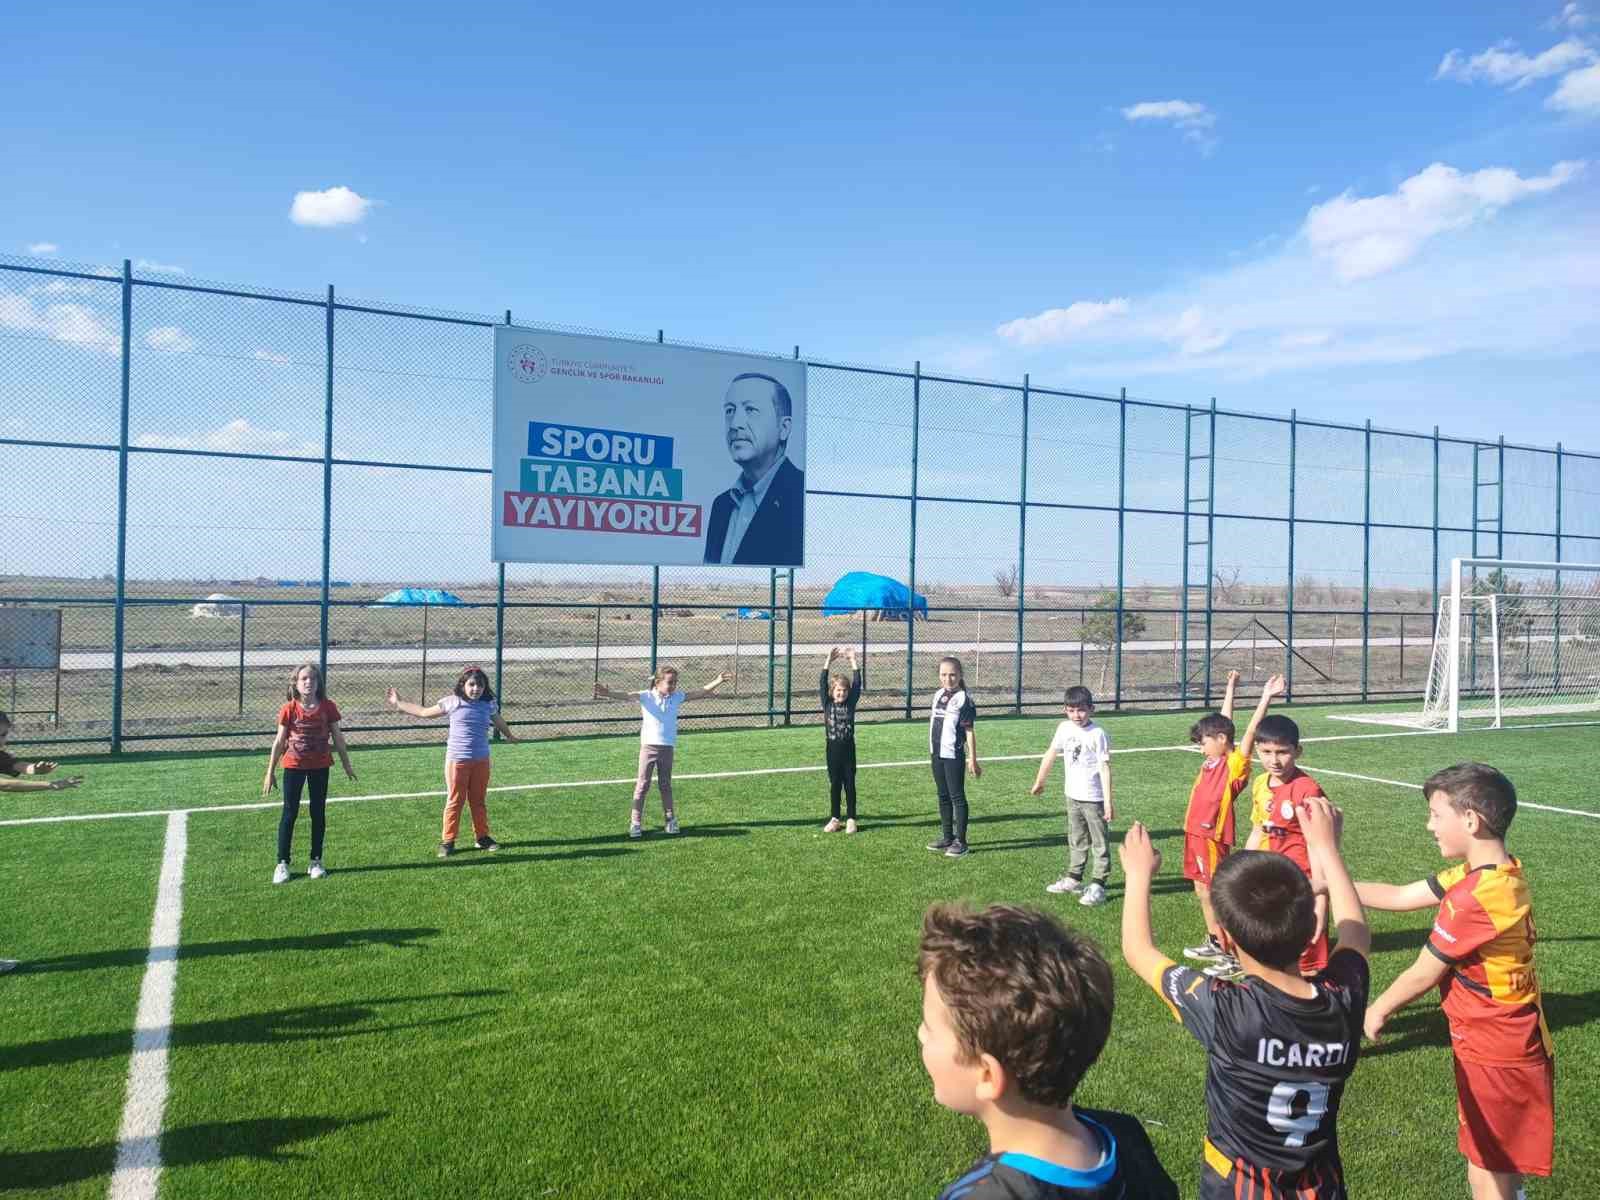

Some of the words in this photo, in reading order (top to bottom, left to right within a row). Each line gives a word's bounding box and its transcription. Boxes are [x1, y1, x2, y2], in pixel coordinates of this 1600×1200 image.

[600, 371, 621, 382] SPOR
[541, 427, 656, 465] SPORU
[530, 464, 670, 497] TABANA
[510, 495, 697, 534] YAYIYORUZ
[1257, 1038, 1350, 1067] ICARDI
[1266, 1082, 1329, 1147] 9
